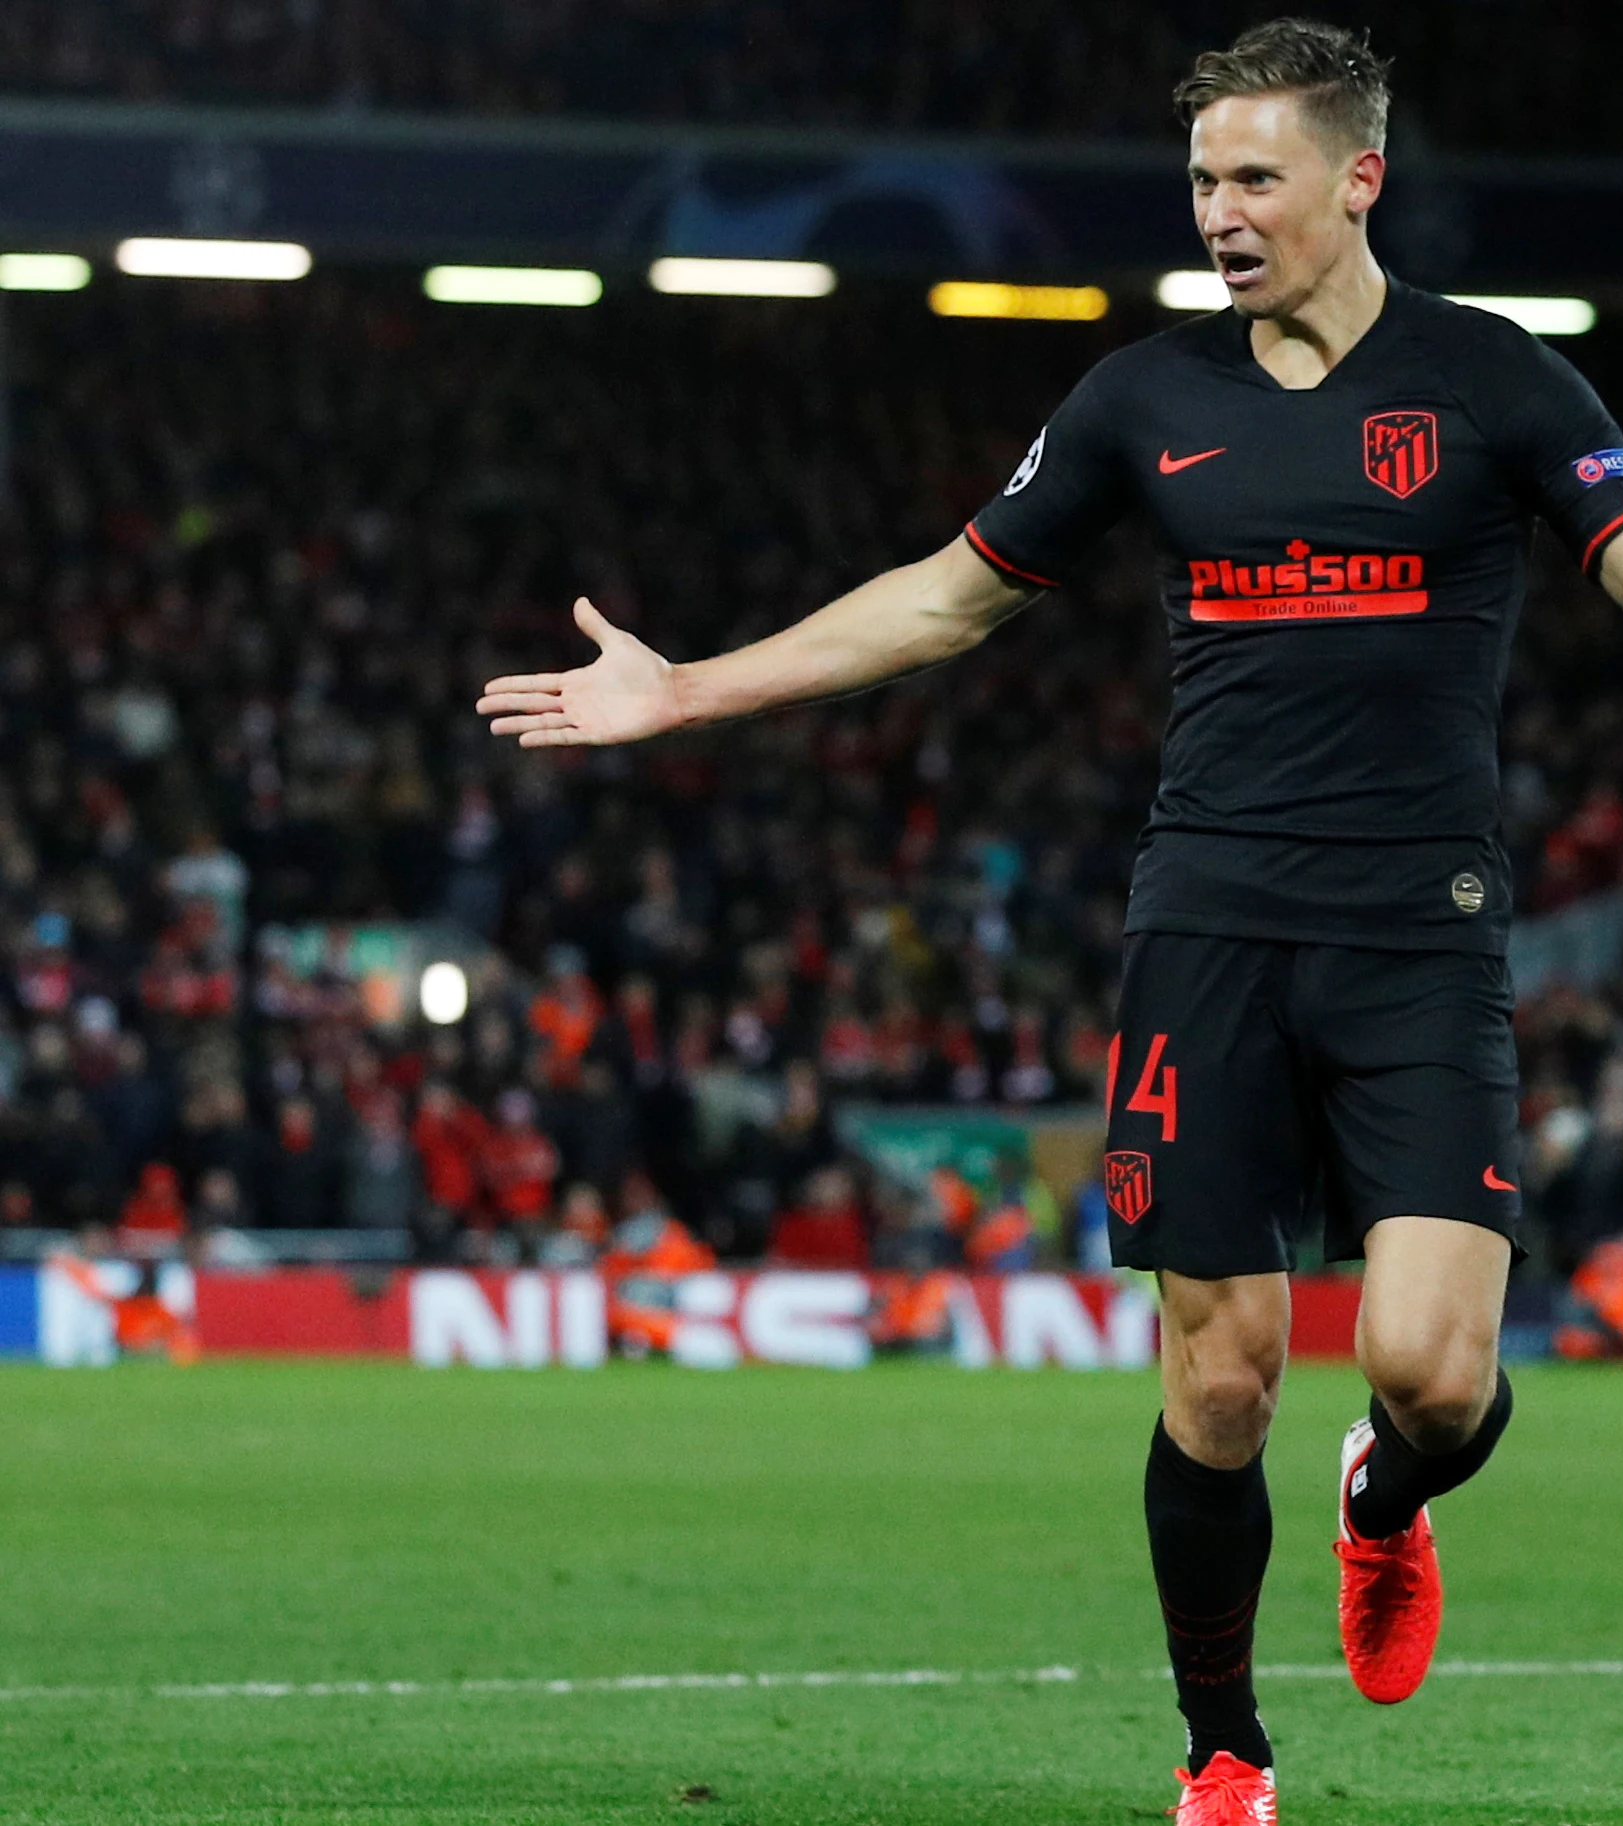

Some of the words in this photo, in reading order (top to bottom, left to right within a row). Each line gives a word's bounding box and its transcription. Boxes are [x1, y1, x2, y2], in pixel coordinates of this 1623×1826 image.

[1189, 553, 1424, 597] Plus500
[1253, 602, 1296, 616] Trade
[1304, 601, 1357, 613] Online
